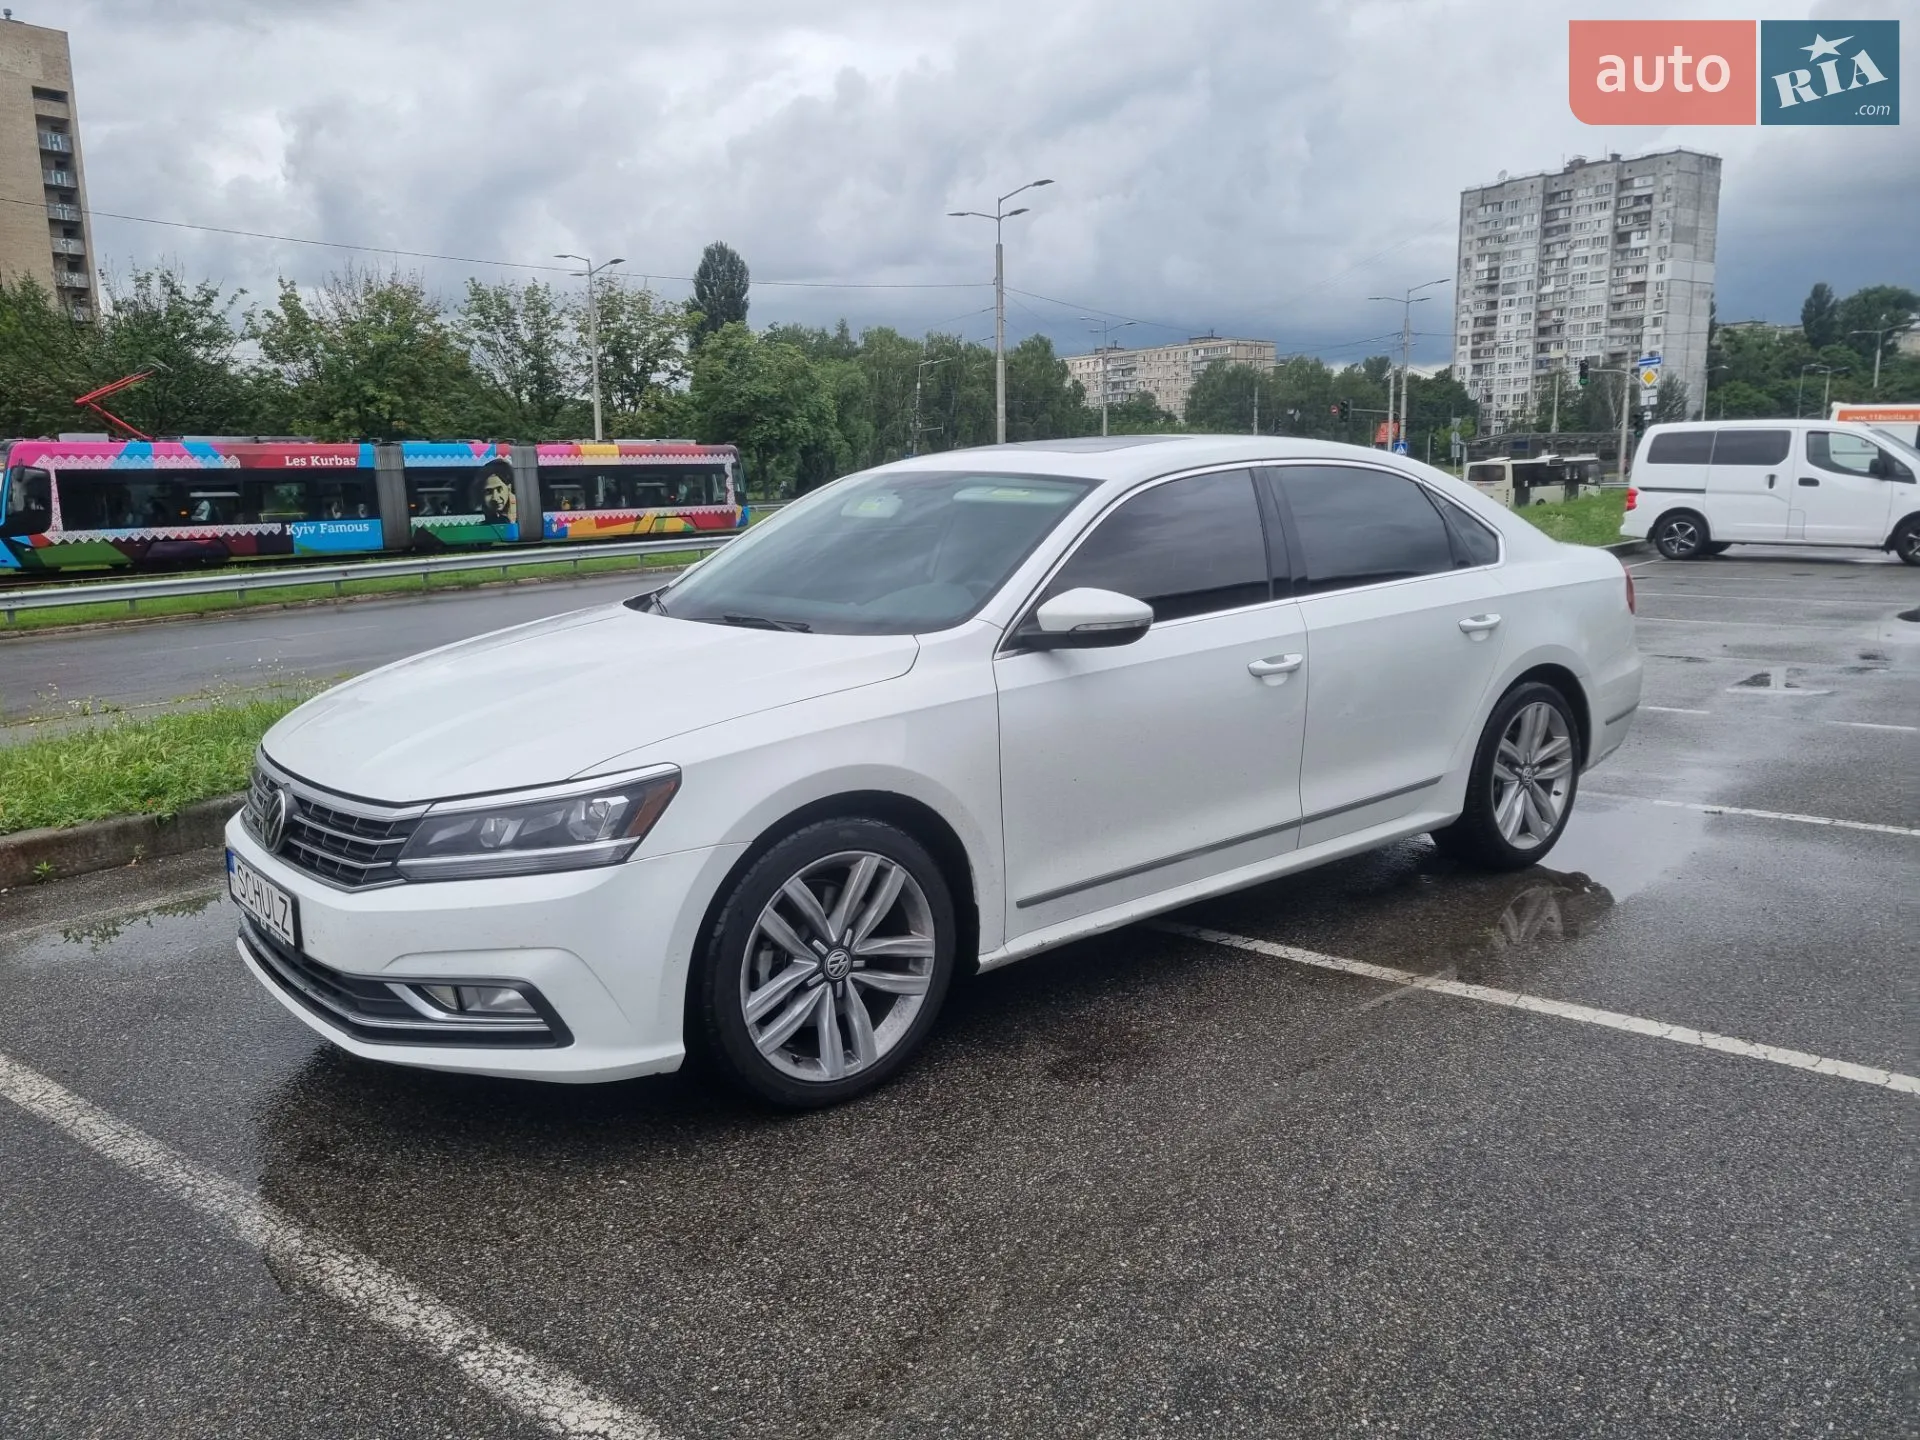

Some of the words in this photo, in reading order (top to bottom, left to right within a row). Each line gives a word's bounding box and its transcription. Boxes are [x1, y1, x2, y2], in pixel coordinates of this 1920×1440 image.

[285, 455, 306, 466] Les
[310, 454, 356, 466] Kurbas
[285, 523, 315, 538] Kyiv
[320, 522, 369, 534] Famous
[236, 863, 291, 937] SCHULZ
